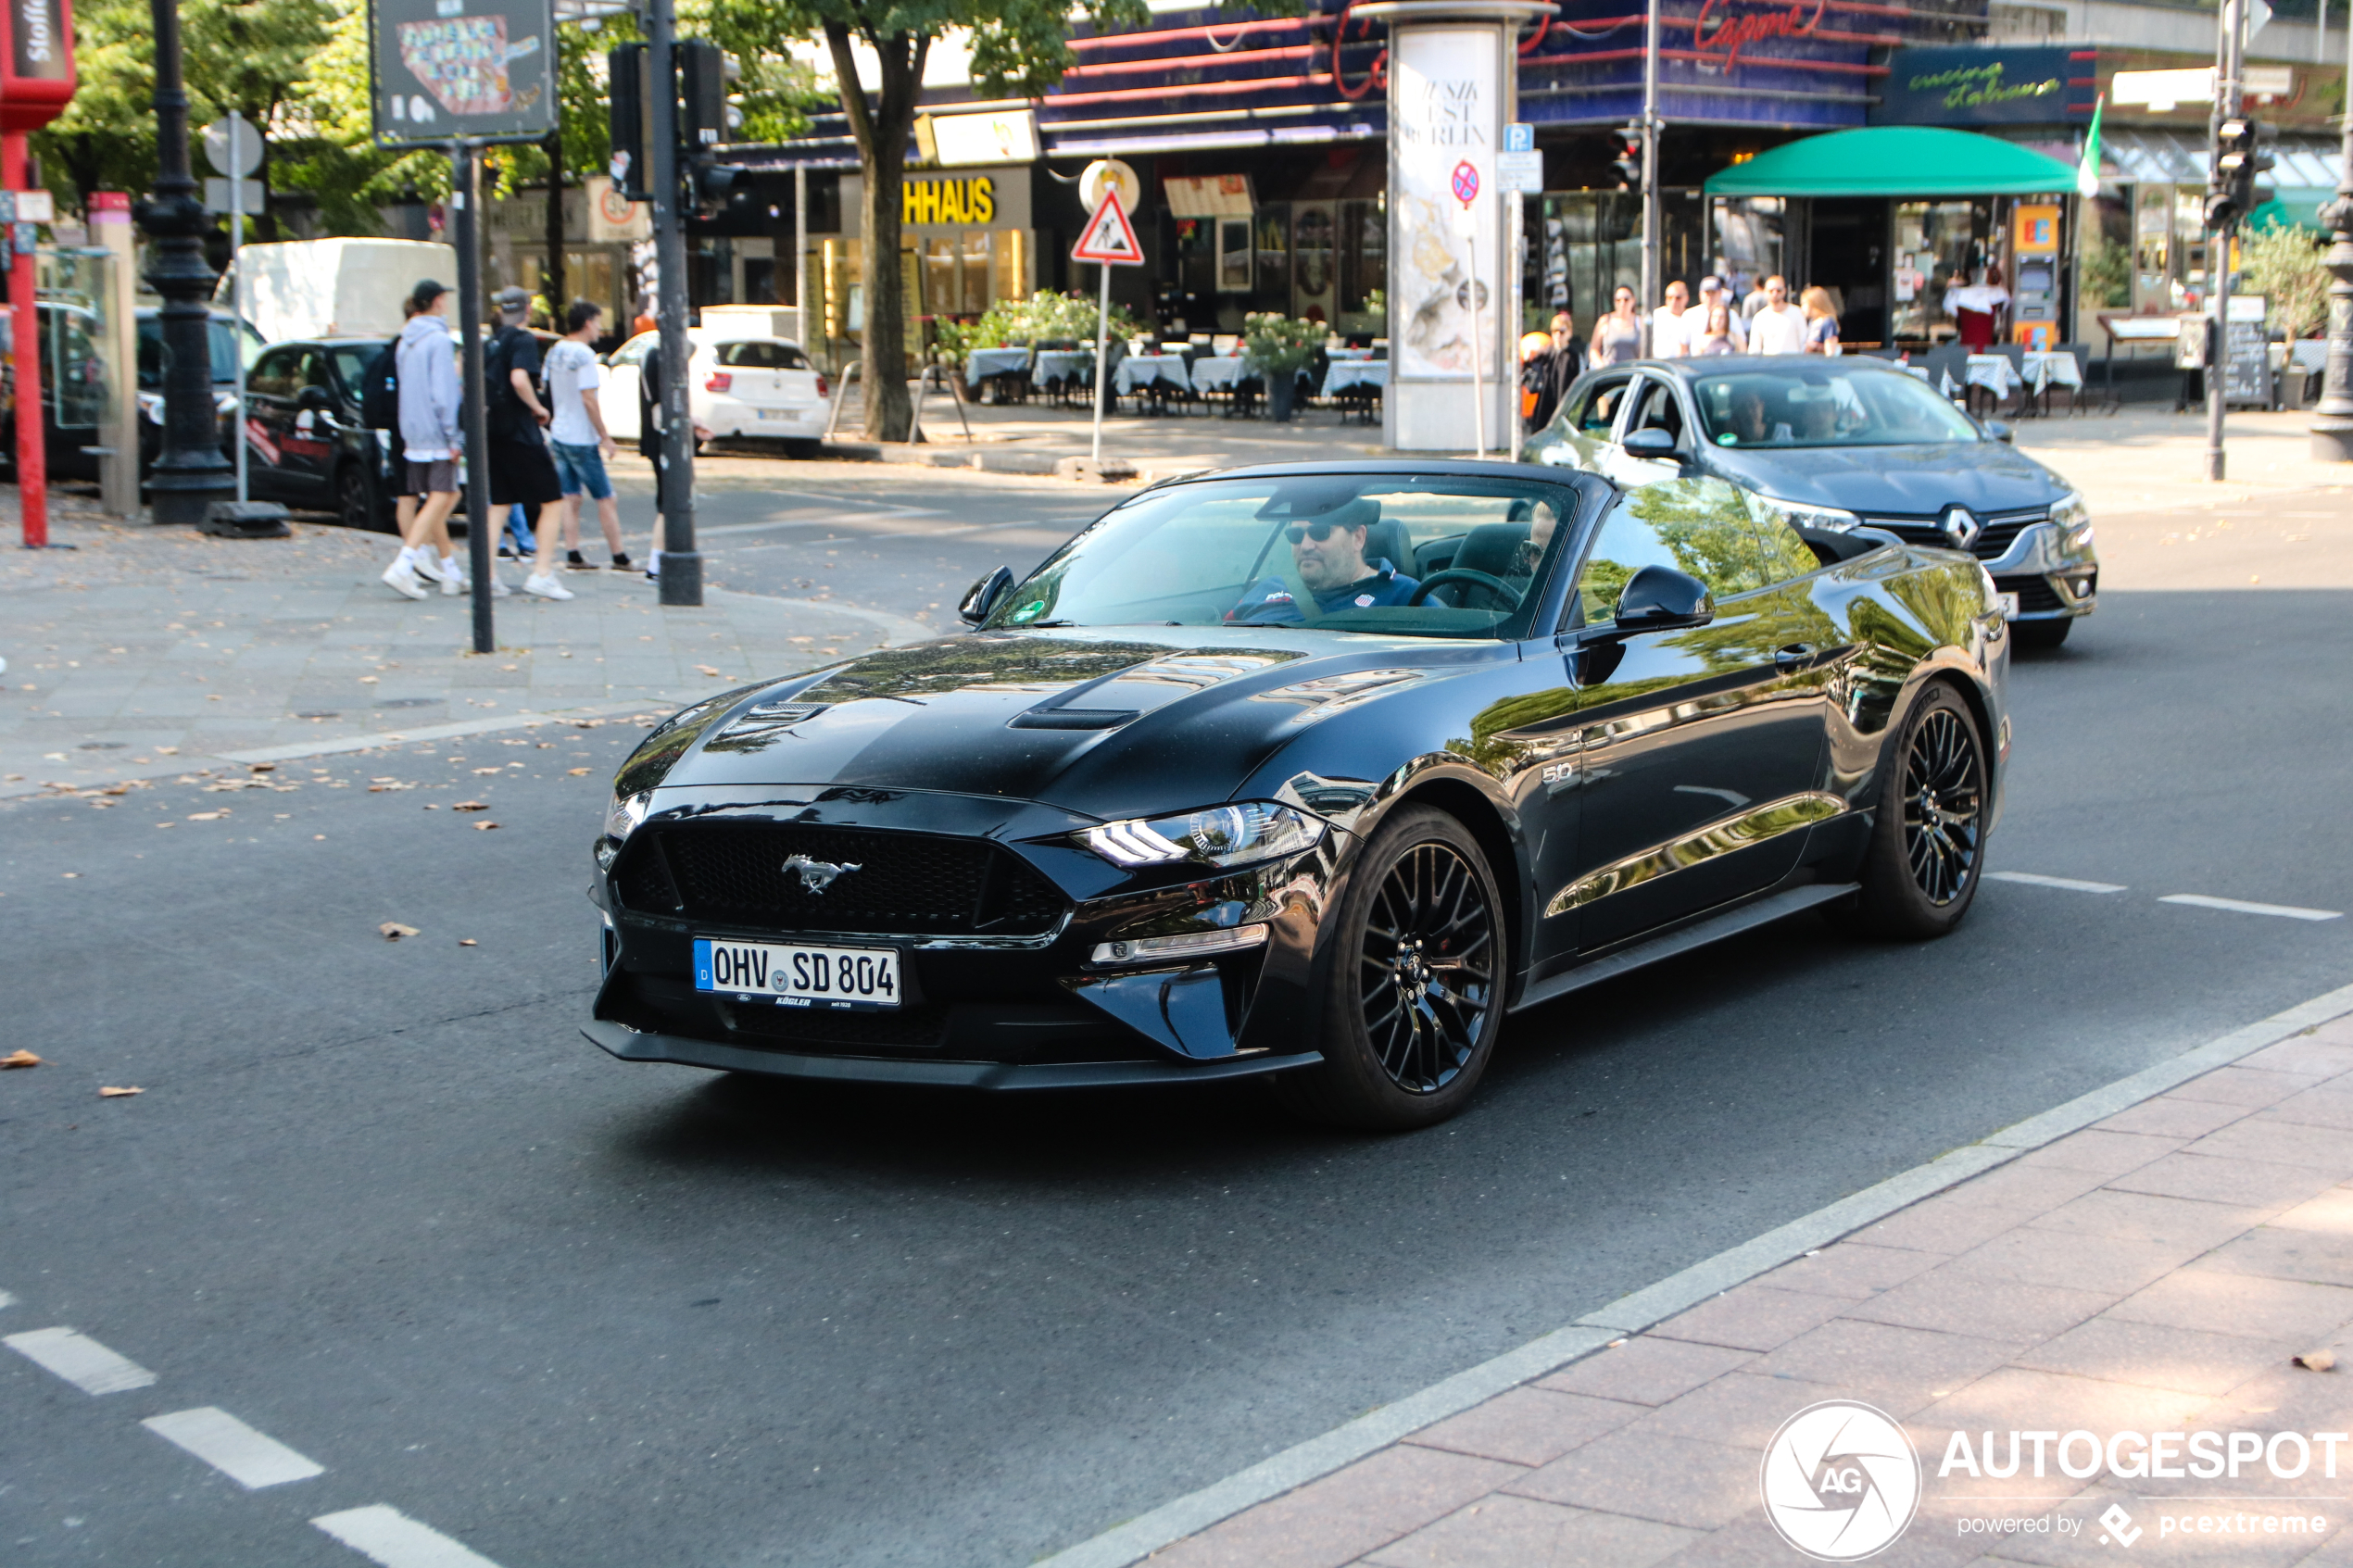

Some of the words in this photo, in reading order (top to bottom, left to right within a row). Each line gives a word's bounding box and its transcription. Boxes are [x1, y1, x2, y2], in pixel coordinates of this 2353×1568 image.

[1908, 61, 2004, 91] cucina
[901, 176, 994, 223] HHAUS
[2024, 219, 2049, 244] EC
[700, 970, 709, 981] D
[714, 947, 768, 987] OHV
[793, 952, 830, 992] SD
[838, 955, 894, 997] 804
[775, 997, 812, 1007] KÖGLER
